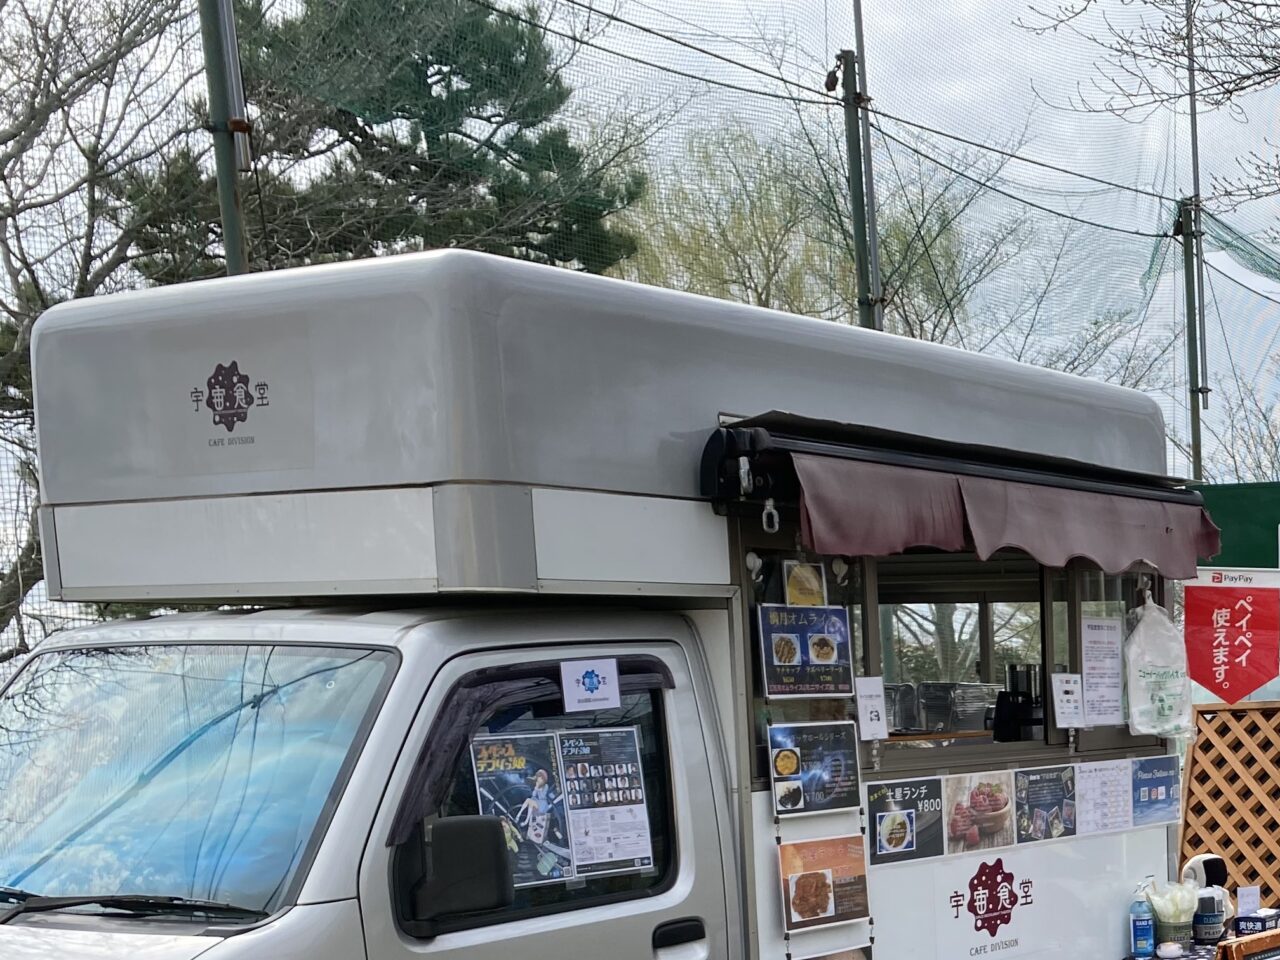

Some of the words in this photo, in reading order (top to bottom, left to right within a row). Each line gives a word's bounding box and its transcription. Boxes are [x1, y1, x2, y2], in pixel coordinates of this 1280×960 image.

[190, 382, 270, 411] 宇宙食堂
[208, 438, 225, 446] CAFE
[227, 436, 255, 445] DIVISION
[1224, 574, 1253, 583] PayPay
[1235, 596, 1253, 667] ペイペイ
[1212, 608, 1231, 689] 使えます。
[885, 785, 928, 802] 土星ランチ
[917, 798, 941, 812] ¥800
[950, 879, 1033, 918] 宇宙食堂
[969, 945, 988, 957] CAFE
[990, 938, 1018, 952] DIVISION
